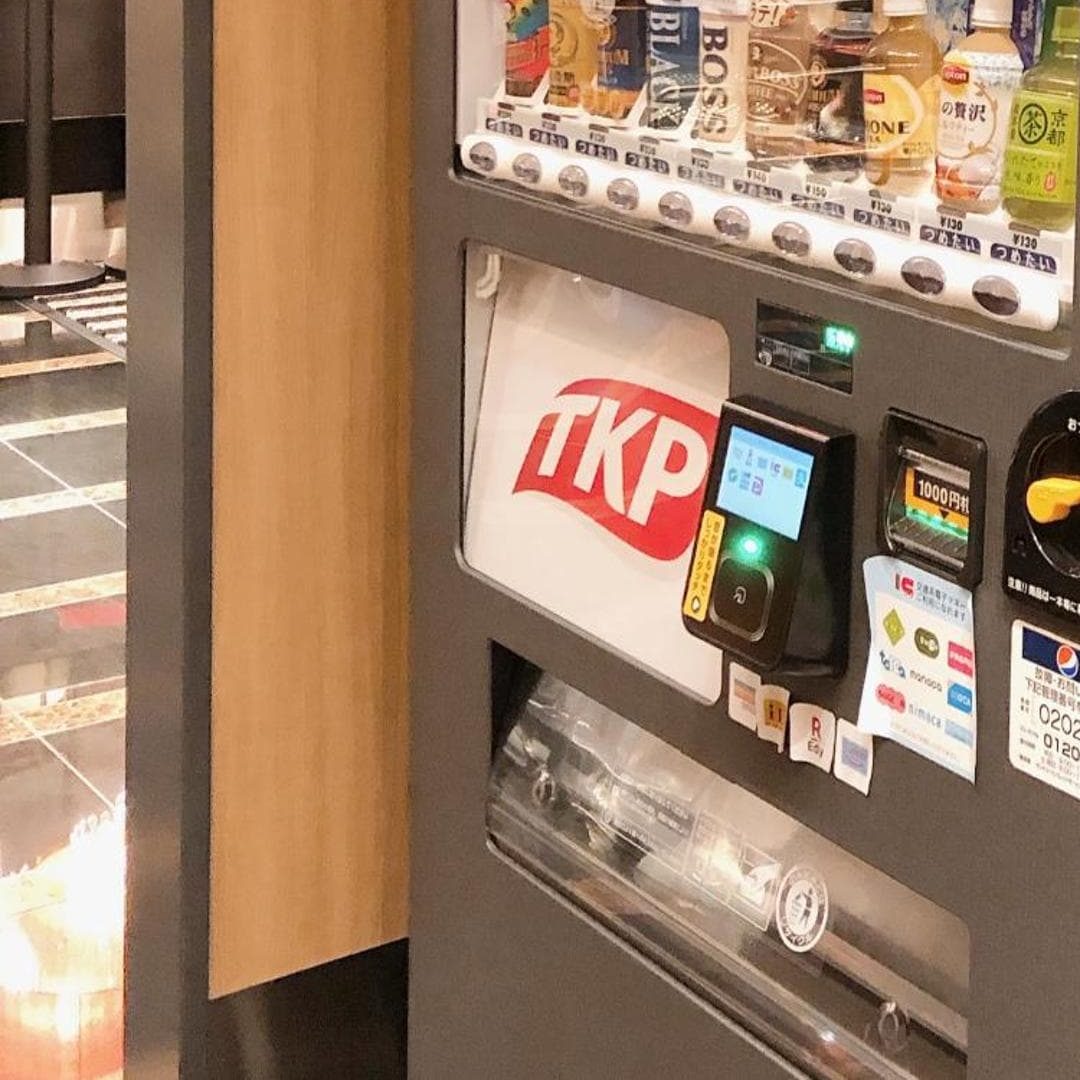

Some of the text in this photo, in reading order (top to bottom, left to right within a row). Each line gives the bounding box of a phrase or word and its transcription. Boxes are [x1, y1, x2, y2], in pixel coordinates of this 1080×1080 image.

[702, 26, 728, 134] BOSS
[1023, 109, 1043, 137] 茶
[941, 217, 963, 231] ¥130
[922, 227, 978, 253] つめたい
[1013, 233, 1038, 249] ¥130
[993, 245, 1055, 272] つめたい
[537, 394, 709, 526] TKP
